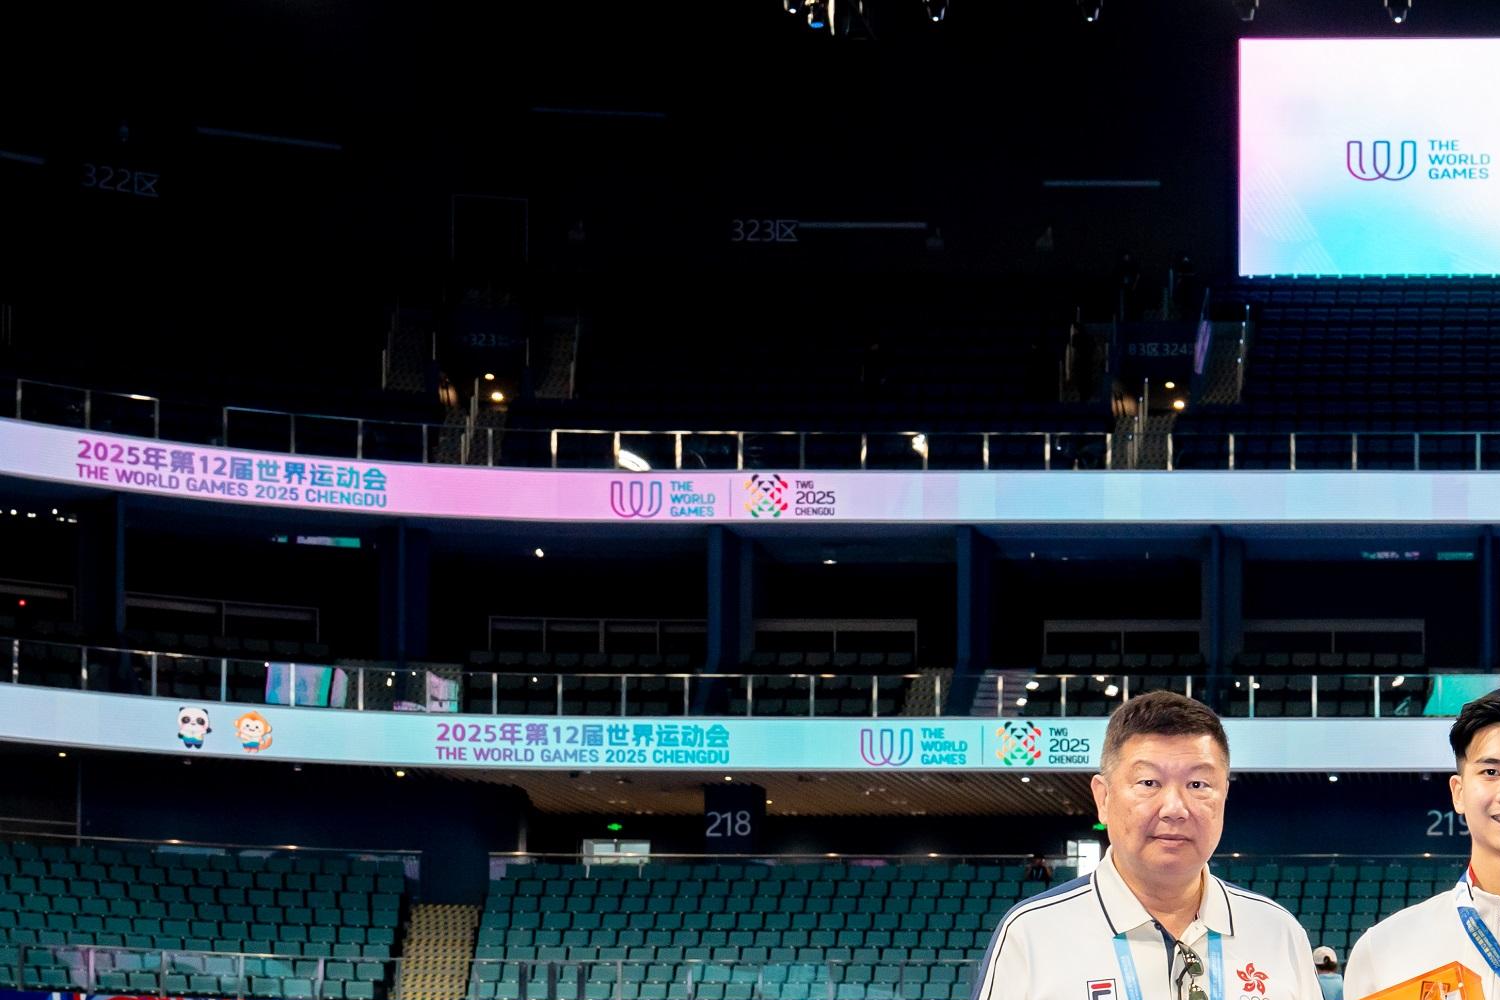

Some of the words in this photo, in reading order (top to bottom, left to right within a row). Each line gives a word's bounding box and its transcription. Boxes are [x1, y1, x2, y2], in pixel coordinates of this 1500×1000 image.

[1428, 139, 1459, 151] THE
[1428, 153, 1491, 166] WORLD
[1428, 167, 1490, 180] GAMES
[82, 164, 159, 197] 322区
[731, 218, 799, 243] 323区
[77, 440, 387, 492] 2025年第12届世界运动会
[76, 463, 109, 481] THE
[115, 468, 180, 490] WORLD
[186, 475, 248, 497] GAMES
[255, 484, 299, 501] 2025
[305, 488, 387, 508] CHENGDU
[670, 481, 693, 492] THE
[795, 480, 814, 489] TWG
[670, 493, 716, 504] WORLD
[795, 491, 836, 504] 2025
[670, 506, 714, 517] GAMES
[795, 507, 835, 516] CHENGDU
[436, 722, 730, 748] 2025年第12届世界运动会
[921, 728, 944, 738] THE
[1049, 728, 1068, 737] TWG
[921, 740, 968, 752] WORLD
[1049, 739, 1090, 753] 2025
[435, 746, 467, 760] THE
[473, 747, 534, 762] WORLD
[540, 748, 599, 763] GAMES
[605, 749, 647, 763] 2025
[652, 750, 730, 764] CHENGDU
[921, 754, 967, 765] GAMES
[1048, 755, 1089, 764] CHENGDU
[705, 811, 751, 838] 218
